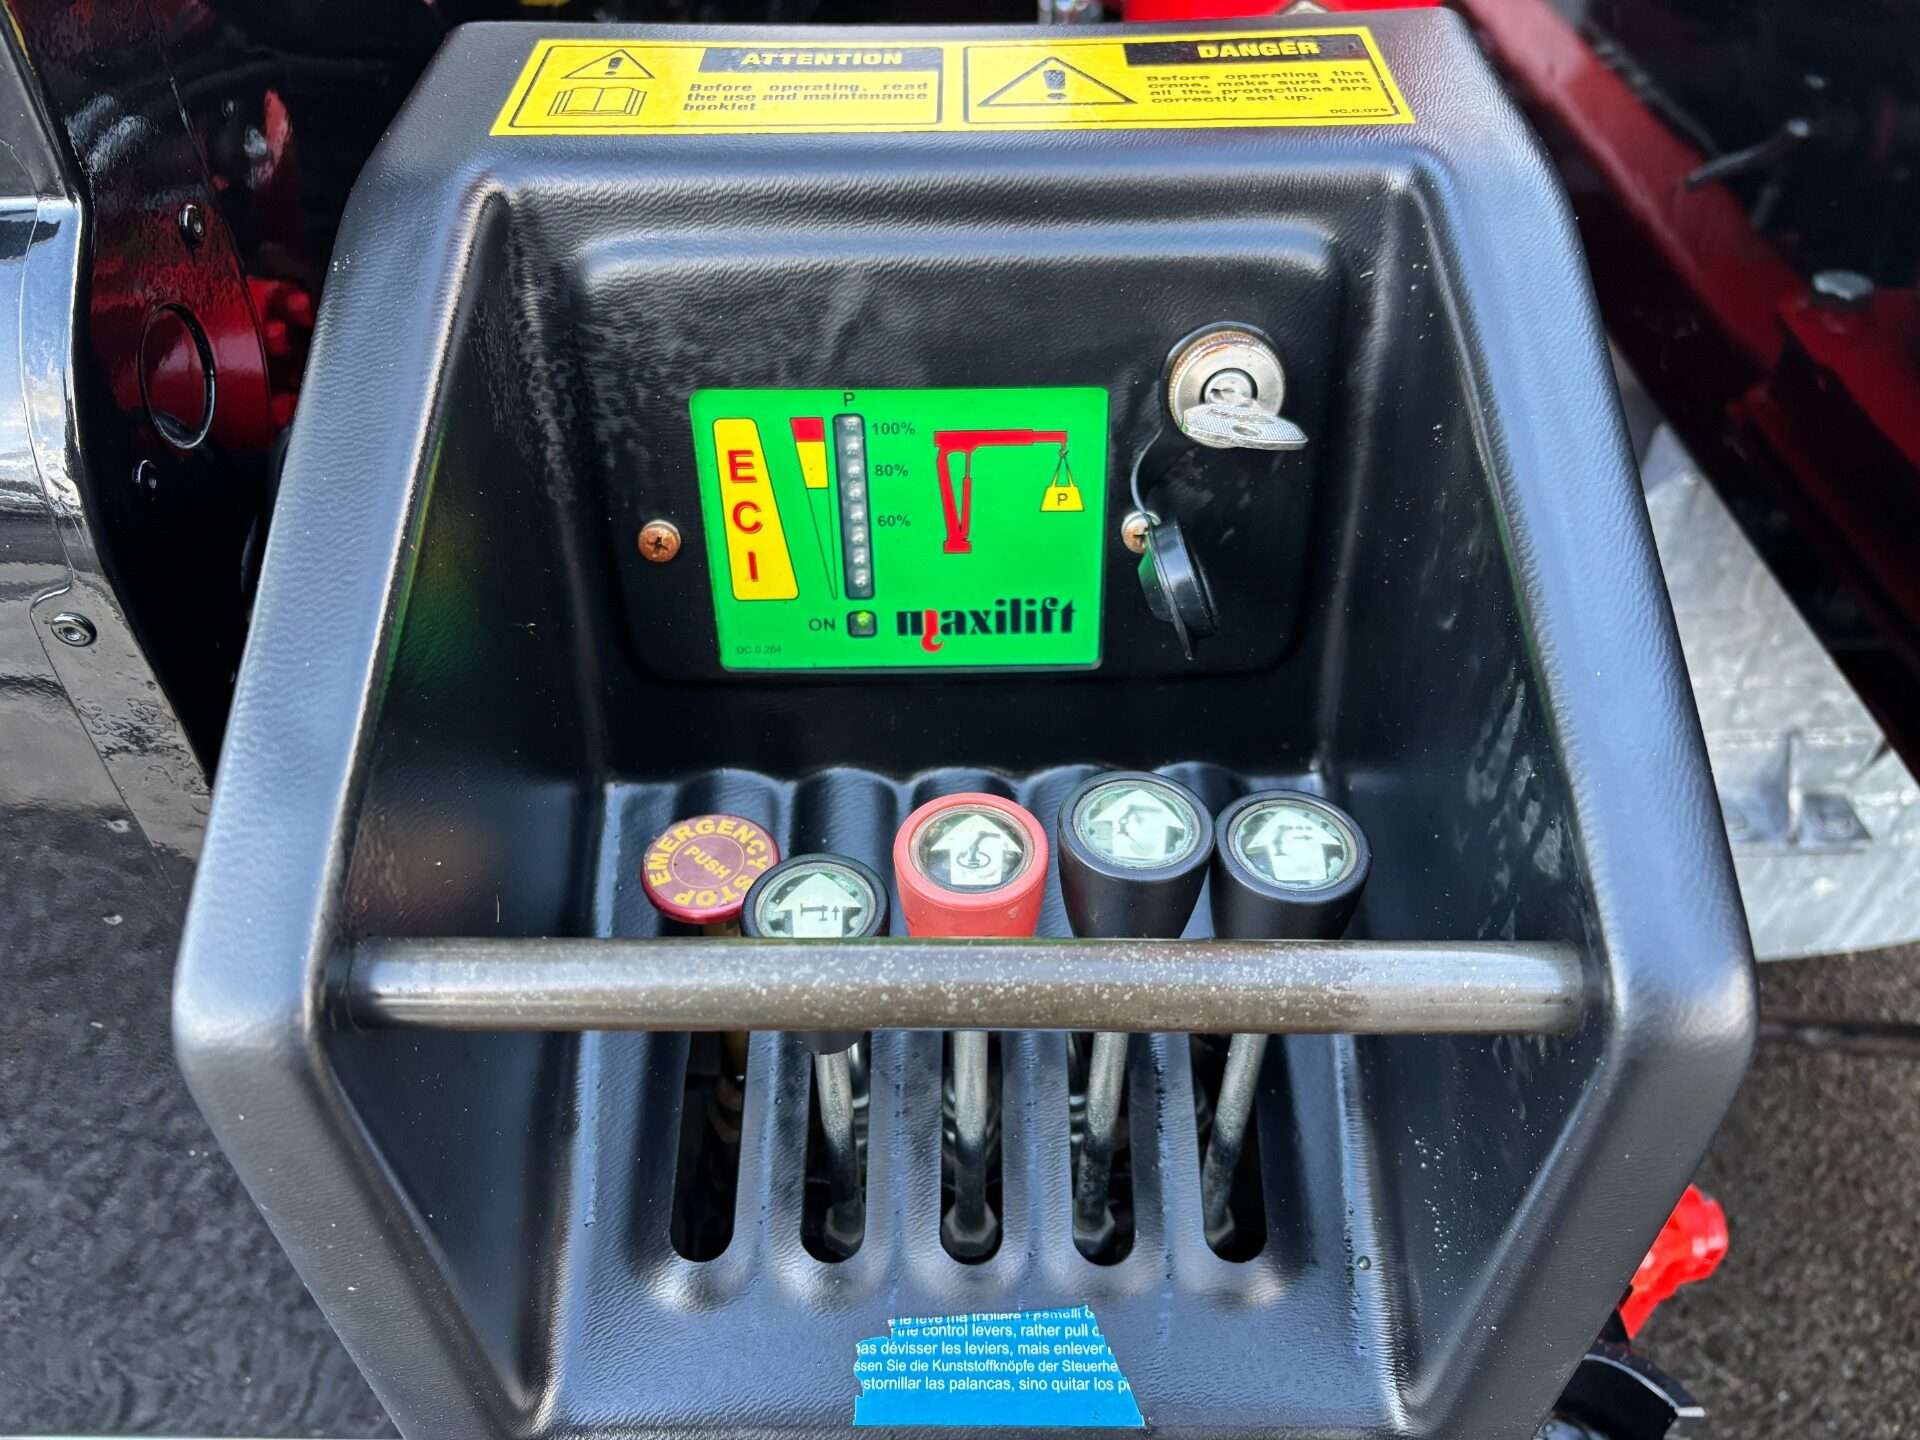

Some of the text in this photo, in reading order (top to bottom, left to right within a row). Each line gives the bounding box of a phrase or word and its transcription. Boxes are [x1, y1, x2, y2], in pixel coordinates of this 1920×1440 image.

[1196, 41, 1320, 59] DANGER
[740, 52, 903, 66] ATTENTION
[1146, 74, 1211, 82] Before
[1225, 71, 1319, 81] operating
[1218, 79, 1269, 87] make
[689, 83, 753, 92] Before
[883, 82, 929, 91] read
[1222, 86, 1333, 96] protections
[687, 92, 928, 102] the use and maintenance
[1151, 95, 1238, 105] correctly
[1284, 96, 1313, 104] up.
[683, 102, 757, 111] booklet
[843, 392, 855, 407] P
[871, 422, 916, 436] 100%
[874, 464, 909, 478] 80%
[1057, 493, 1068, 506] P
[877, 515, 911, 528] 60%
[808, 618, 837, 632] ON
[896, 596, 1077, 653] maxilift
[648, 820, 769, 887] EMERGENCY
[683, 846, 732, 879] PUSH
[673, 874, 753, 907] STOP
[922, 1323, 968, 1337] control
[972, 1323, 1017, 1339] levers,
[1020, 1323, 1062, 1337] rather
[1064, 1323, 1089, 1340] pull
[880, 1340, 938, 1355] dévisser
[941, 1340, 961, 1355] les
[965, 1340, 1013, 1357] leviers,
[1018, 1341, 1050, 1355] mais
[1053, 1341, 1105, 1355] enlever
[853, 1359, 1118, 1375] ssen Sie die Kunststoffknöpfe der Steuerhe
[925, 1376, 945, 1391] las
[949, 1376, 1015, 1393] palancas,
[1018, 1376, 1048, 1391] sino
[1051, 1376, 1090, 1394] quitar
[1094, 1376, 1114, 1391] los
